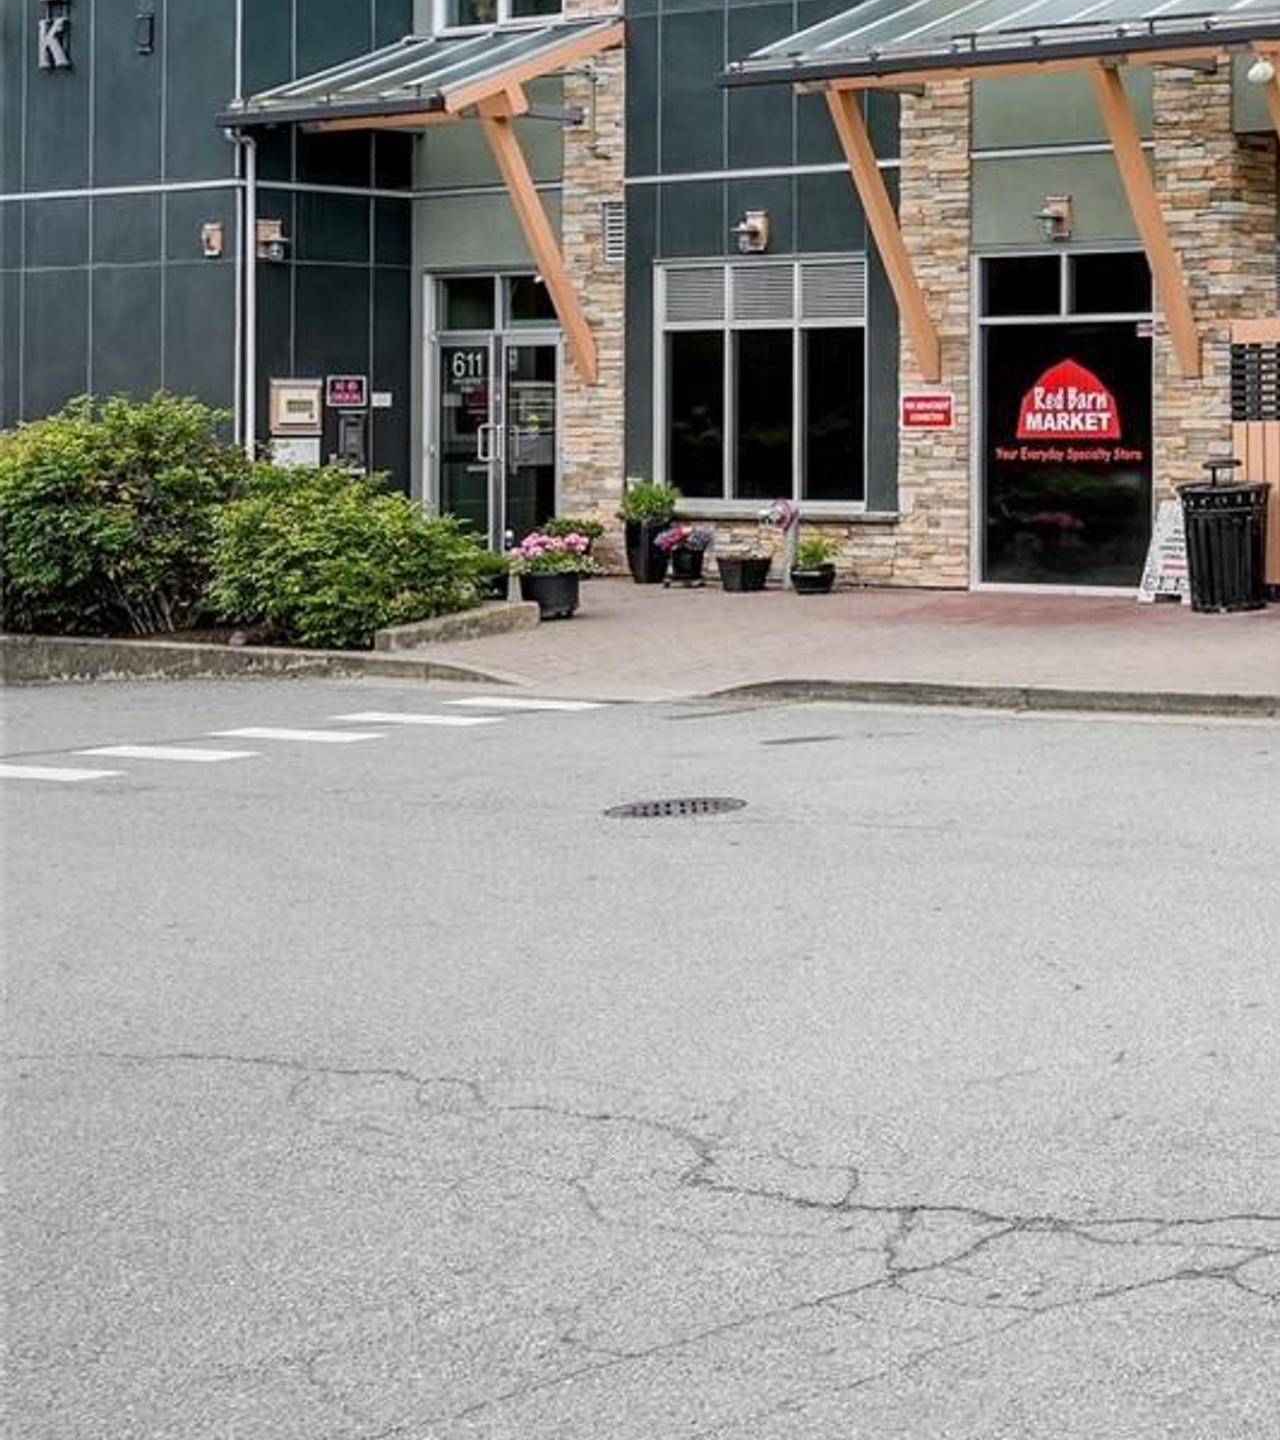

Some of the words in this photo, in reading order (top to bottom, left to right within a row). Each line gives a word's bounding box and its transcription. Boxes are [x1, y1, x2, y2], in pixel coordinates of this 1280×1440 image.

[453, 351, 482, 378] 611
[1033, 386, 1064, 410] Red
[1067, 386, 1108, 410] Barn
[1026, 412, 1112, 432] MARKET
